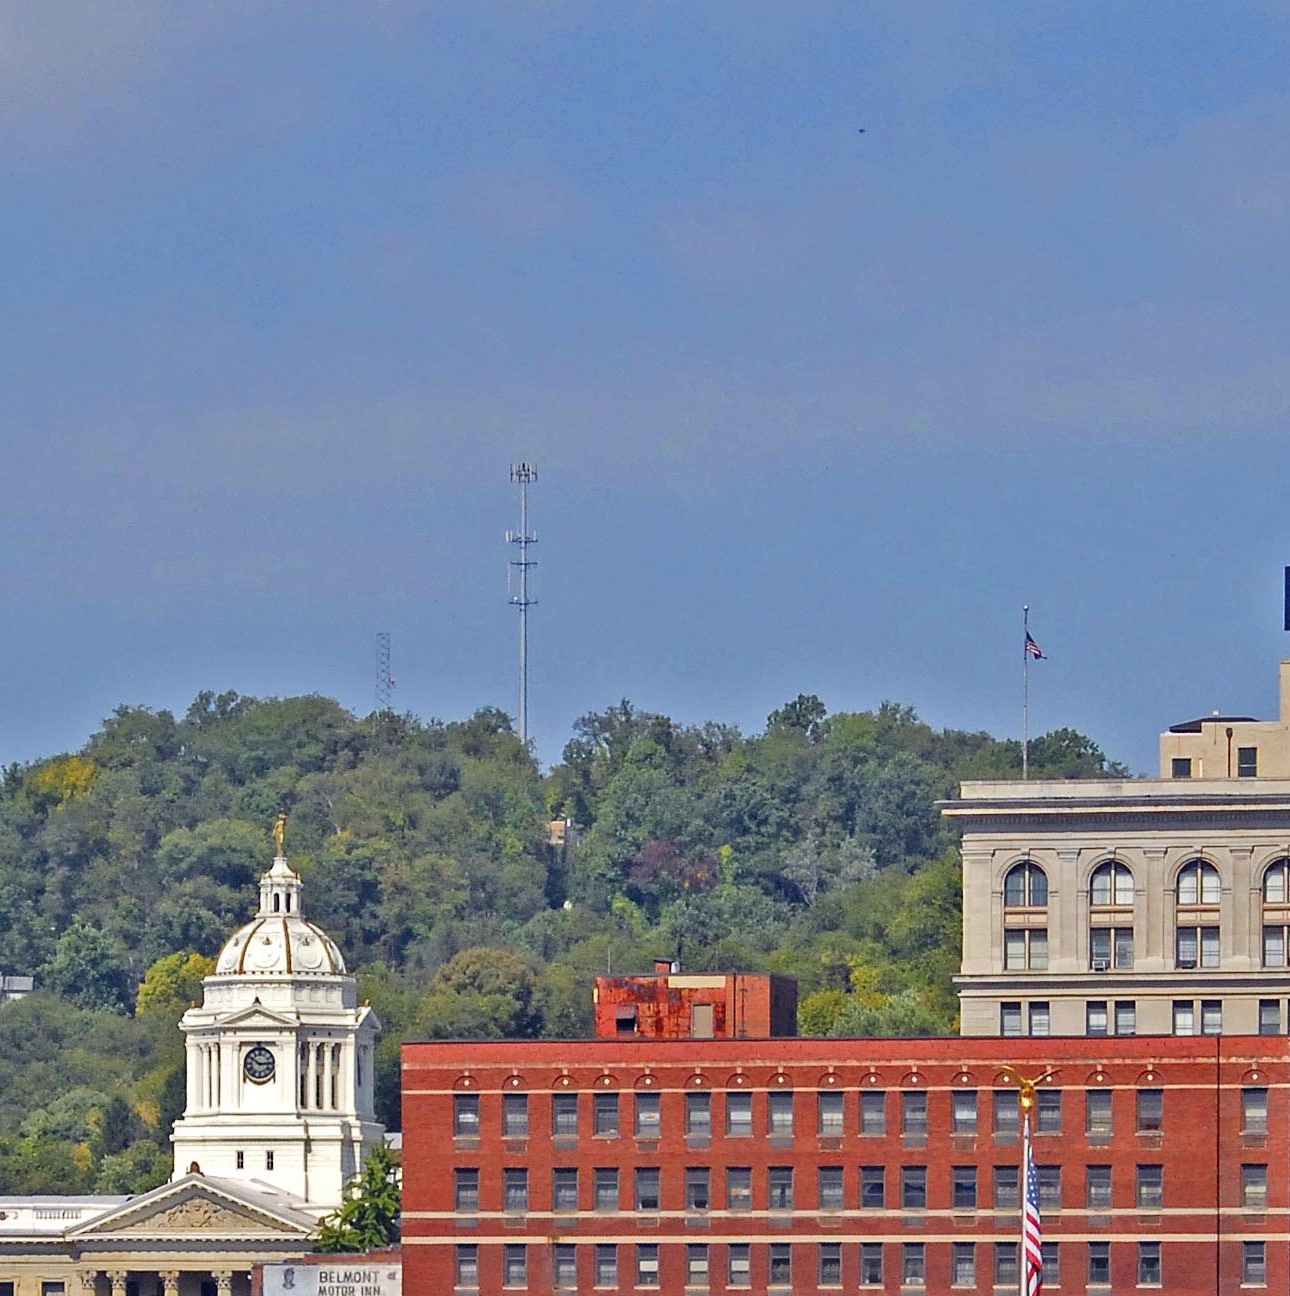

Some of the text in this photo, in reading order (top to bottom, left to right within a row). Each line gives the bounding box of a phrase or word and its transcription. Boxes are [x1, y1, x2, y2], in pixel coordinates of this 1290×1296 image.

[319, 1271, 380, 1284] BELMONT
[318, 1286, 381, 1296] MOTOR INN
